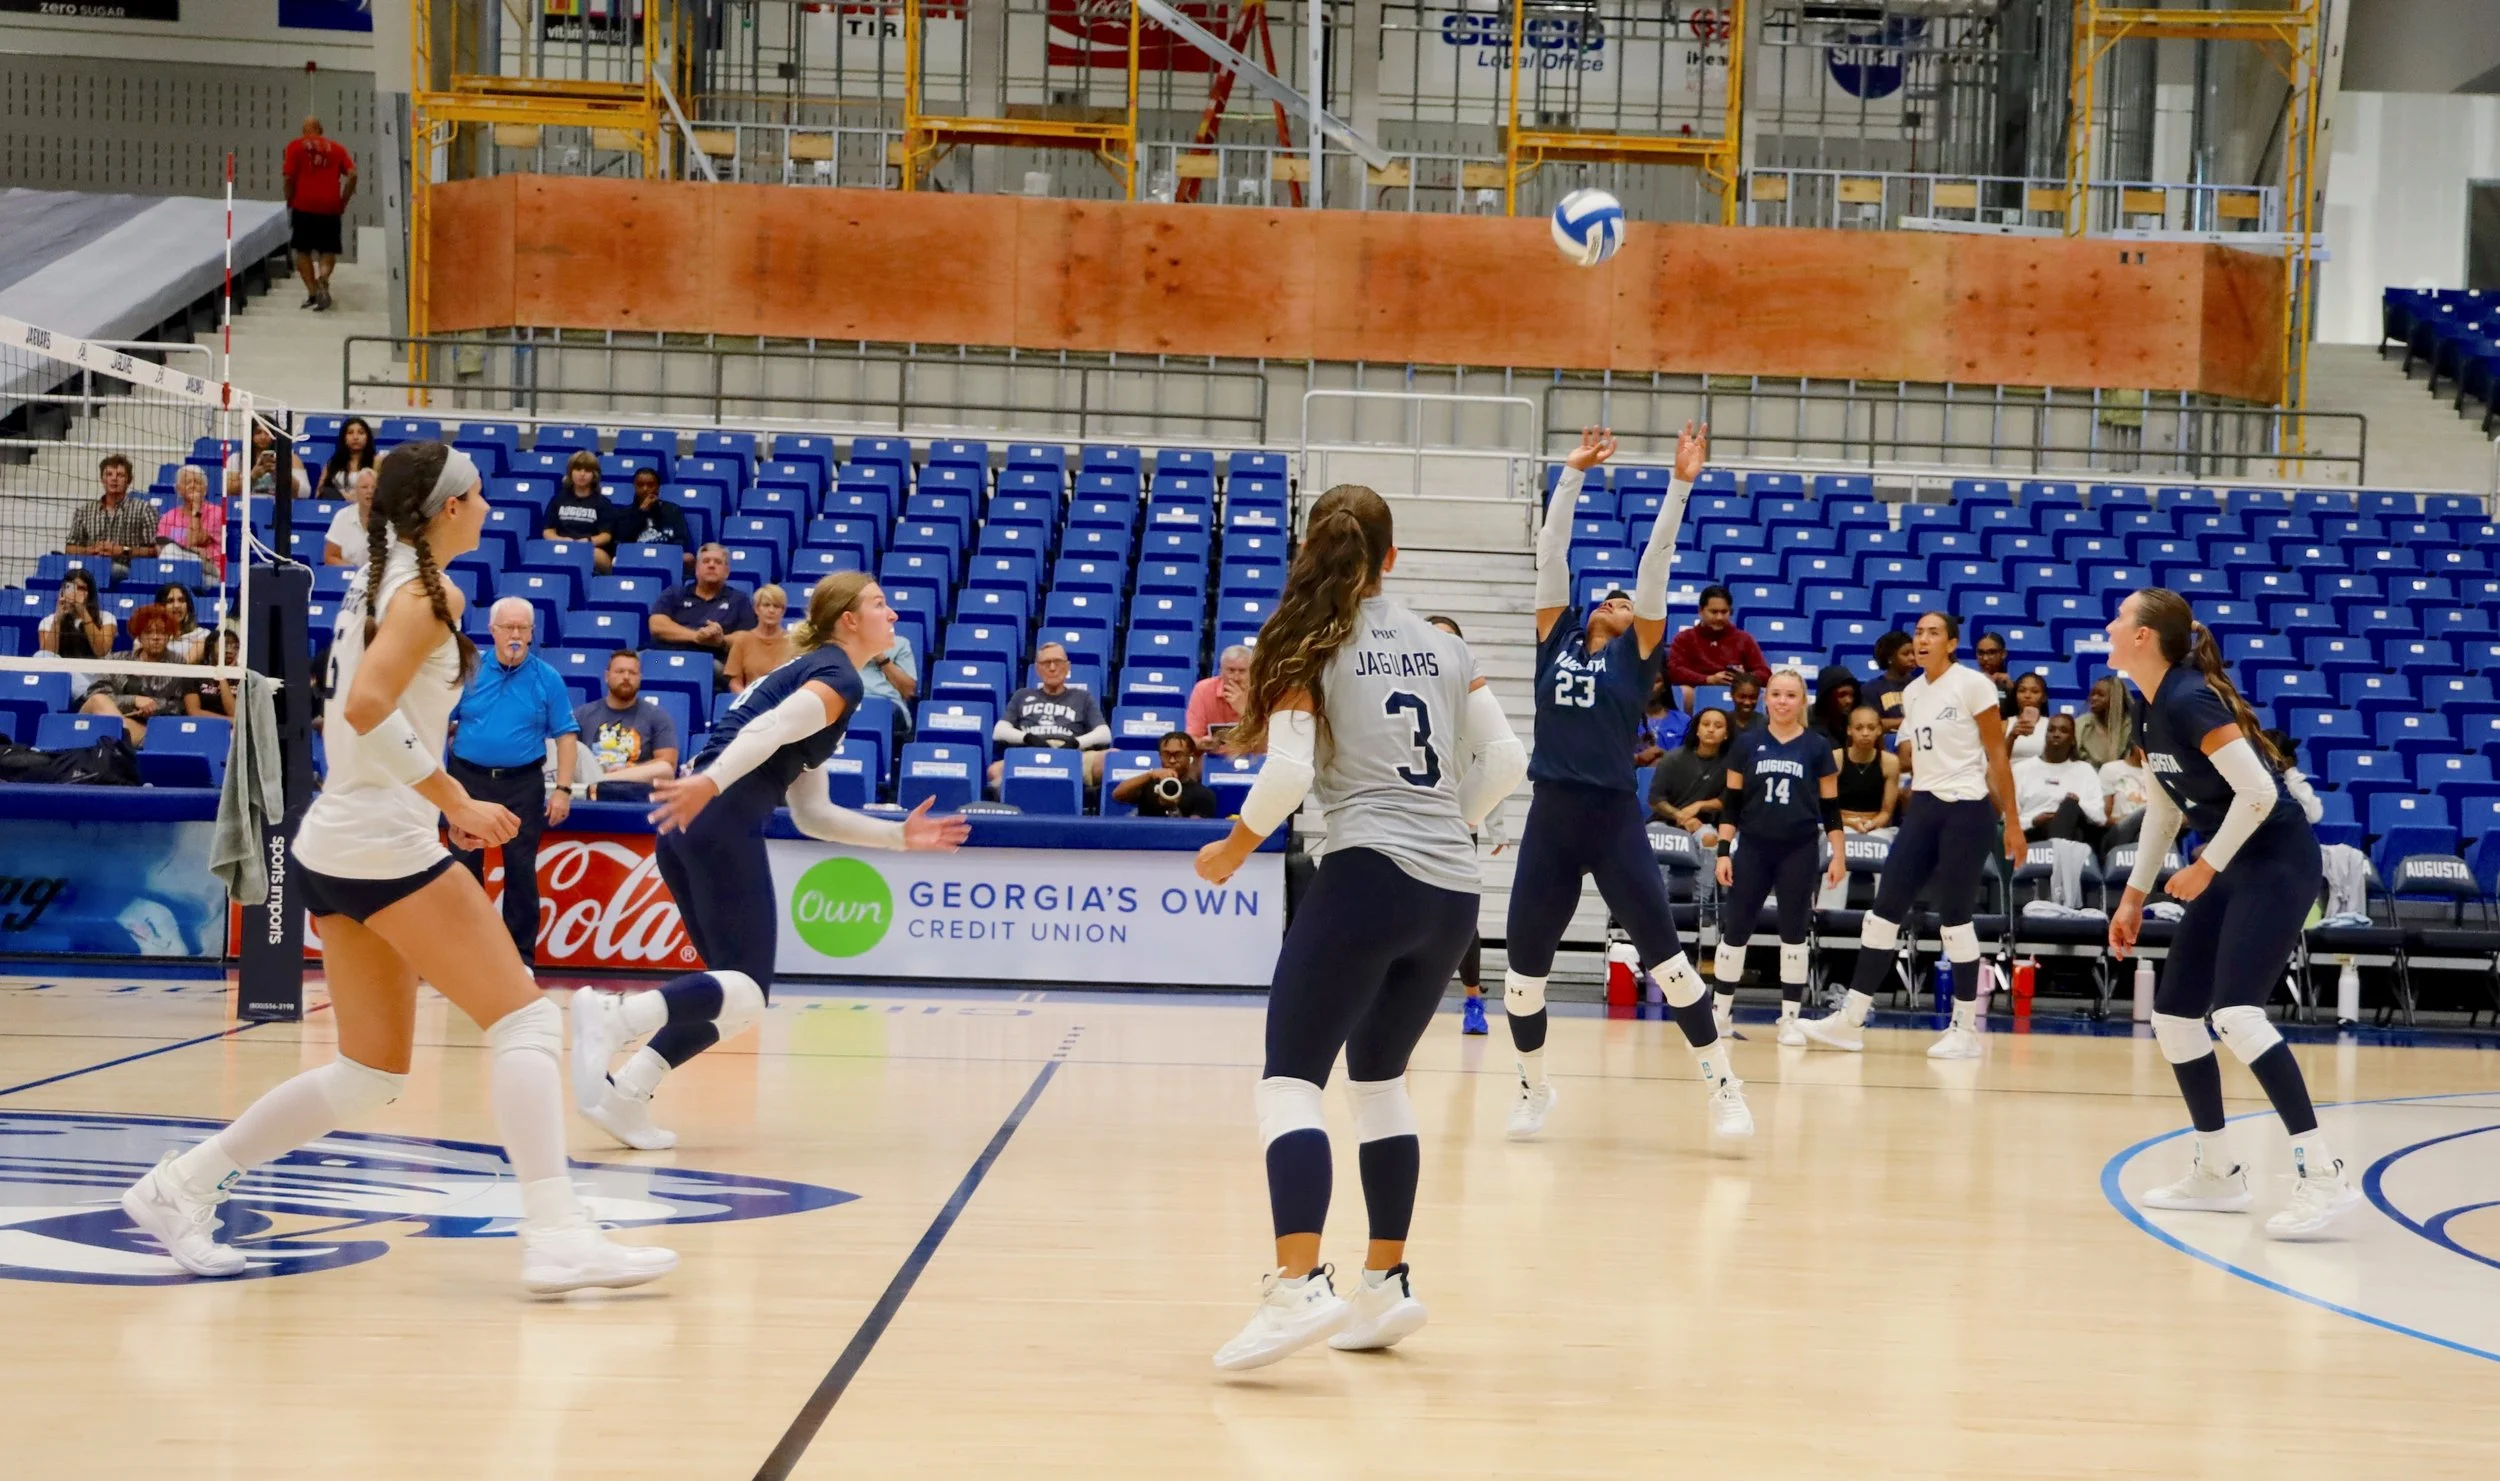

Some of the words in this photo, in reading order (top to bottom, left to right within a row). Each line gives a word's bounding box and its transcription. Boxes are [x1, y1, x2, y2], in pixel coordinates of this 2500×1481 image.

[40, 2, 76, 14] zero
[80, 6, 125, 17] SUGAR
[847, 20, 908, 37] TIR
[1543, 53, 1604, 71] Office
[558, 505, 597, 520] AUGUSTA
[1356, 651, 1440, 677] JAGUARS
[1554, 650, 1607, 673] AUGSTA
[1554, 669, 1597, 708] 23
[1022, 702, 1077, 722] UCONN
[1380, 687, 1443, 790] 3
[1915, 726, 1933, 752] 13
[1755, 759, 1804, 778] AUGUSTA
[2146, 751, 2183, 773] GUSTA
[1764, 776, 1791, 805] 14
[1647, 833, 1690, 852] GUSTA
[1826, 840, 1889, 860] AGUSTA
[269, 835, 286, 884] sports
[2406, 860, 2469, 880] AUGUSTA
[798, 889, 883, 924] Own
[908, 881, 1138, 913] GEORGIA'S
[1160, 887, 1259, 916] OWN
[267, 885, 284, 945] imports
[908, 918, 1015, 941] CREDIT
[1031, 922, 1127, 945] UNION
